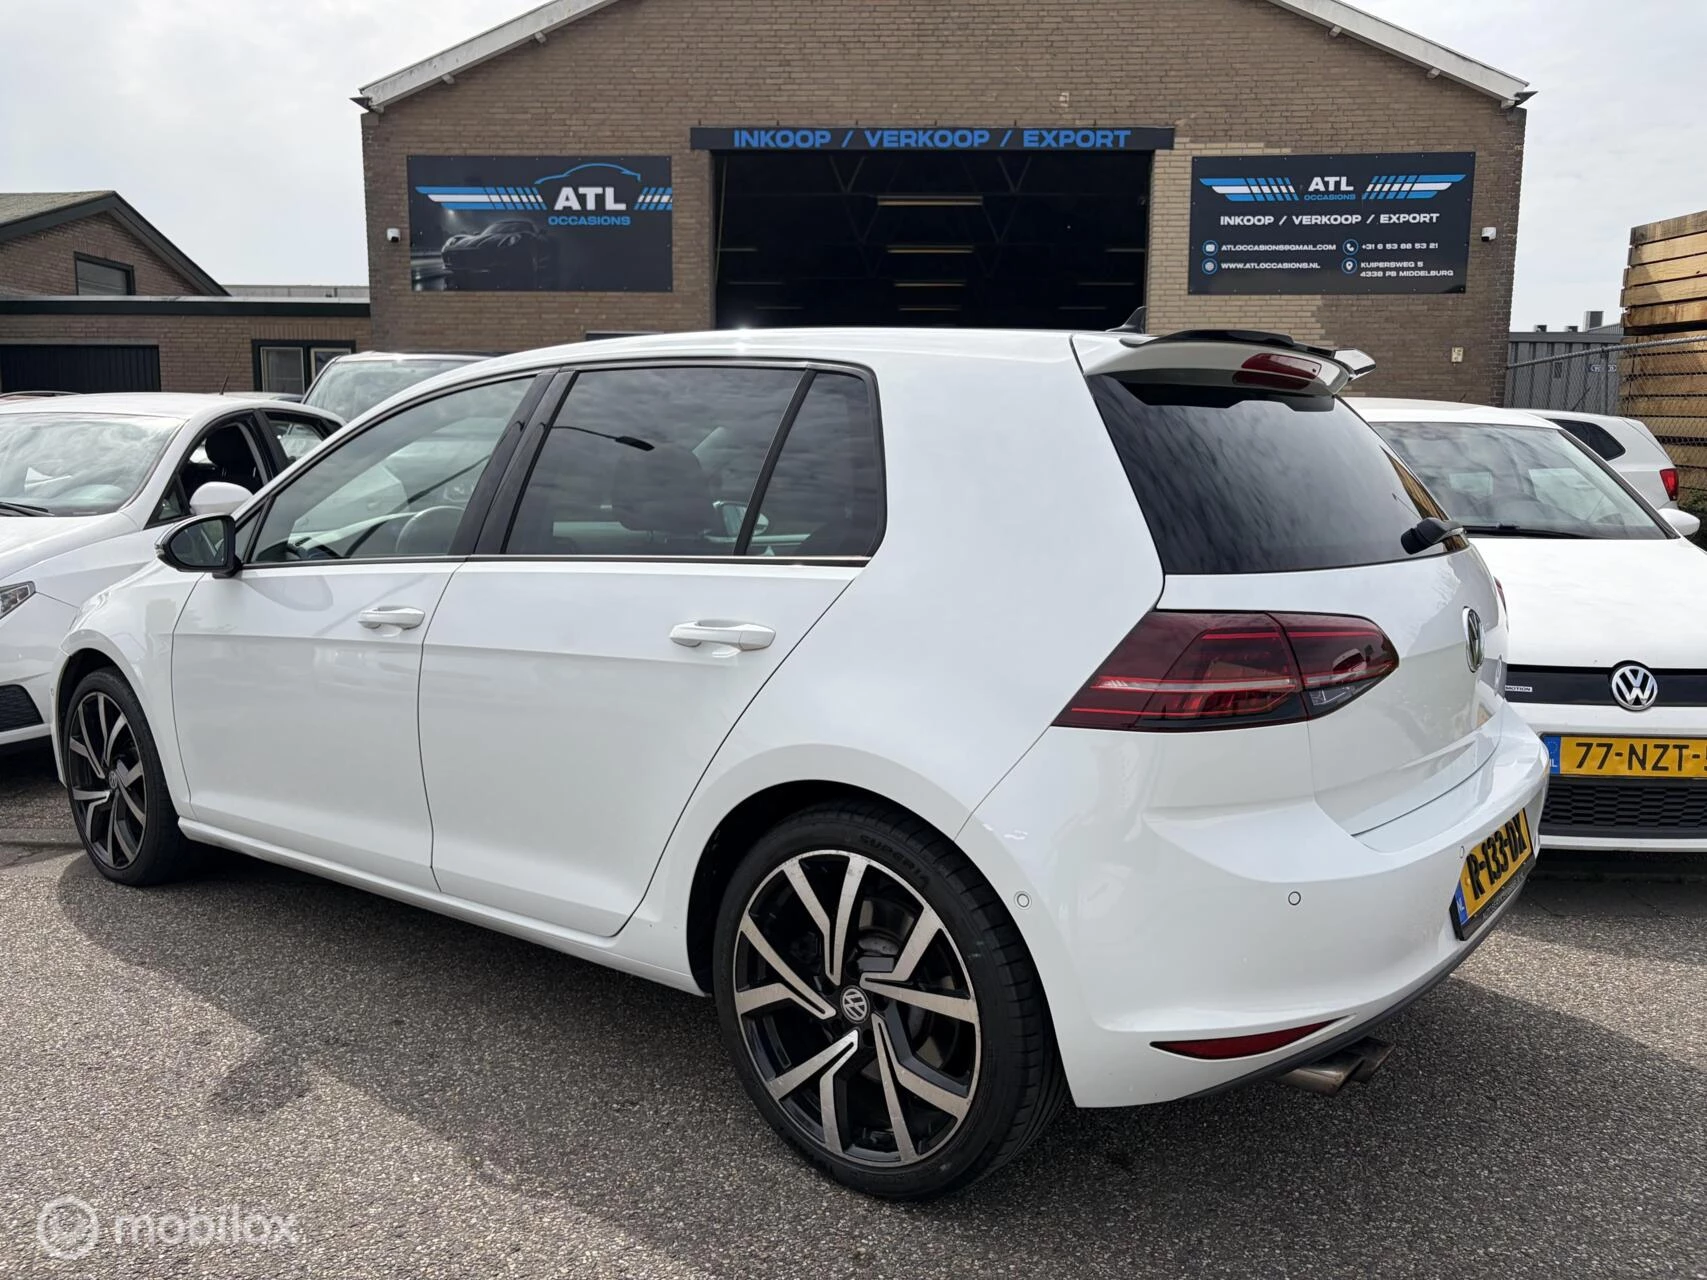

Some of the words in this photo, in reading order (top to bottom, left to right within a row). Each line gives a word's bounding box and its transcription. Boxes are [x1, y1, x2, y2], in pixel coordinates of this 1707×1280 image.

[733, 130, 831, 149] INKOOP
[841, 130, 853, 149] /
[864, 130, 990, 148] VERKOOP
[1000, 129, 1013, 148] /
[1023, 129, 1131, 148] EXPORT
[1308, 176, 1354, 192] ATL
[554, 187, 627, 210] ATL
[548, 215, 631, 226] OCCASIONS
[1220, 215, 1274, 226] INKOOP
[1279, 215, 1288, 225] /
[1292, 214, 1362, 225] VERKOOP
[1366, 214, 1375, 224] /
[1379, 213, 1440, 224] EXPORT
[1575, 742, 1707, 772] 77-NZT-
